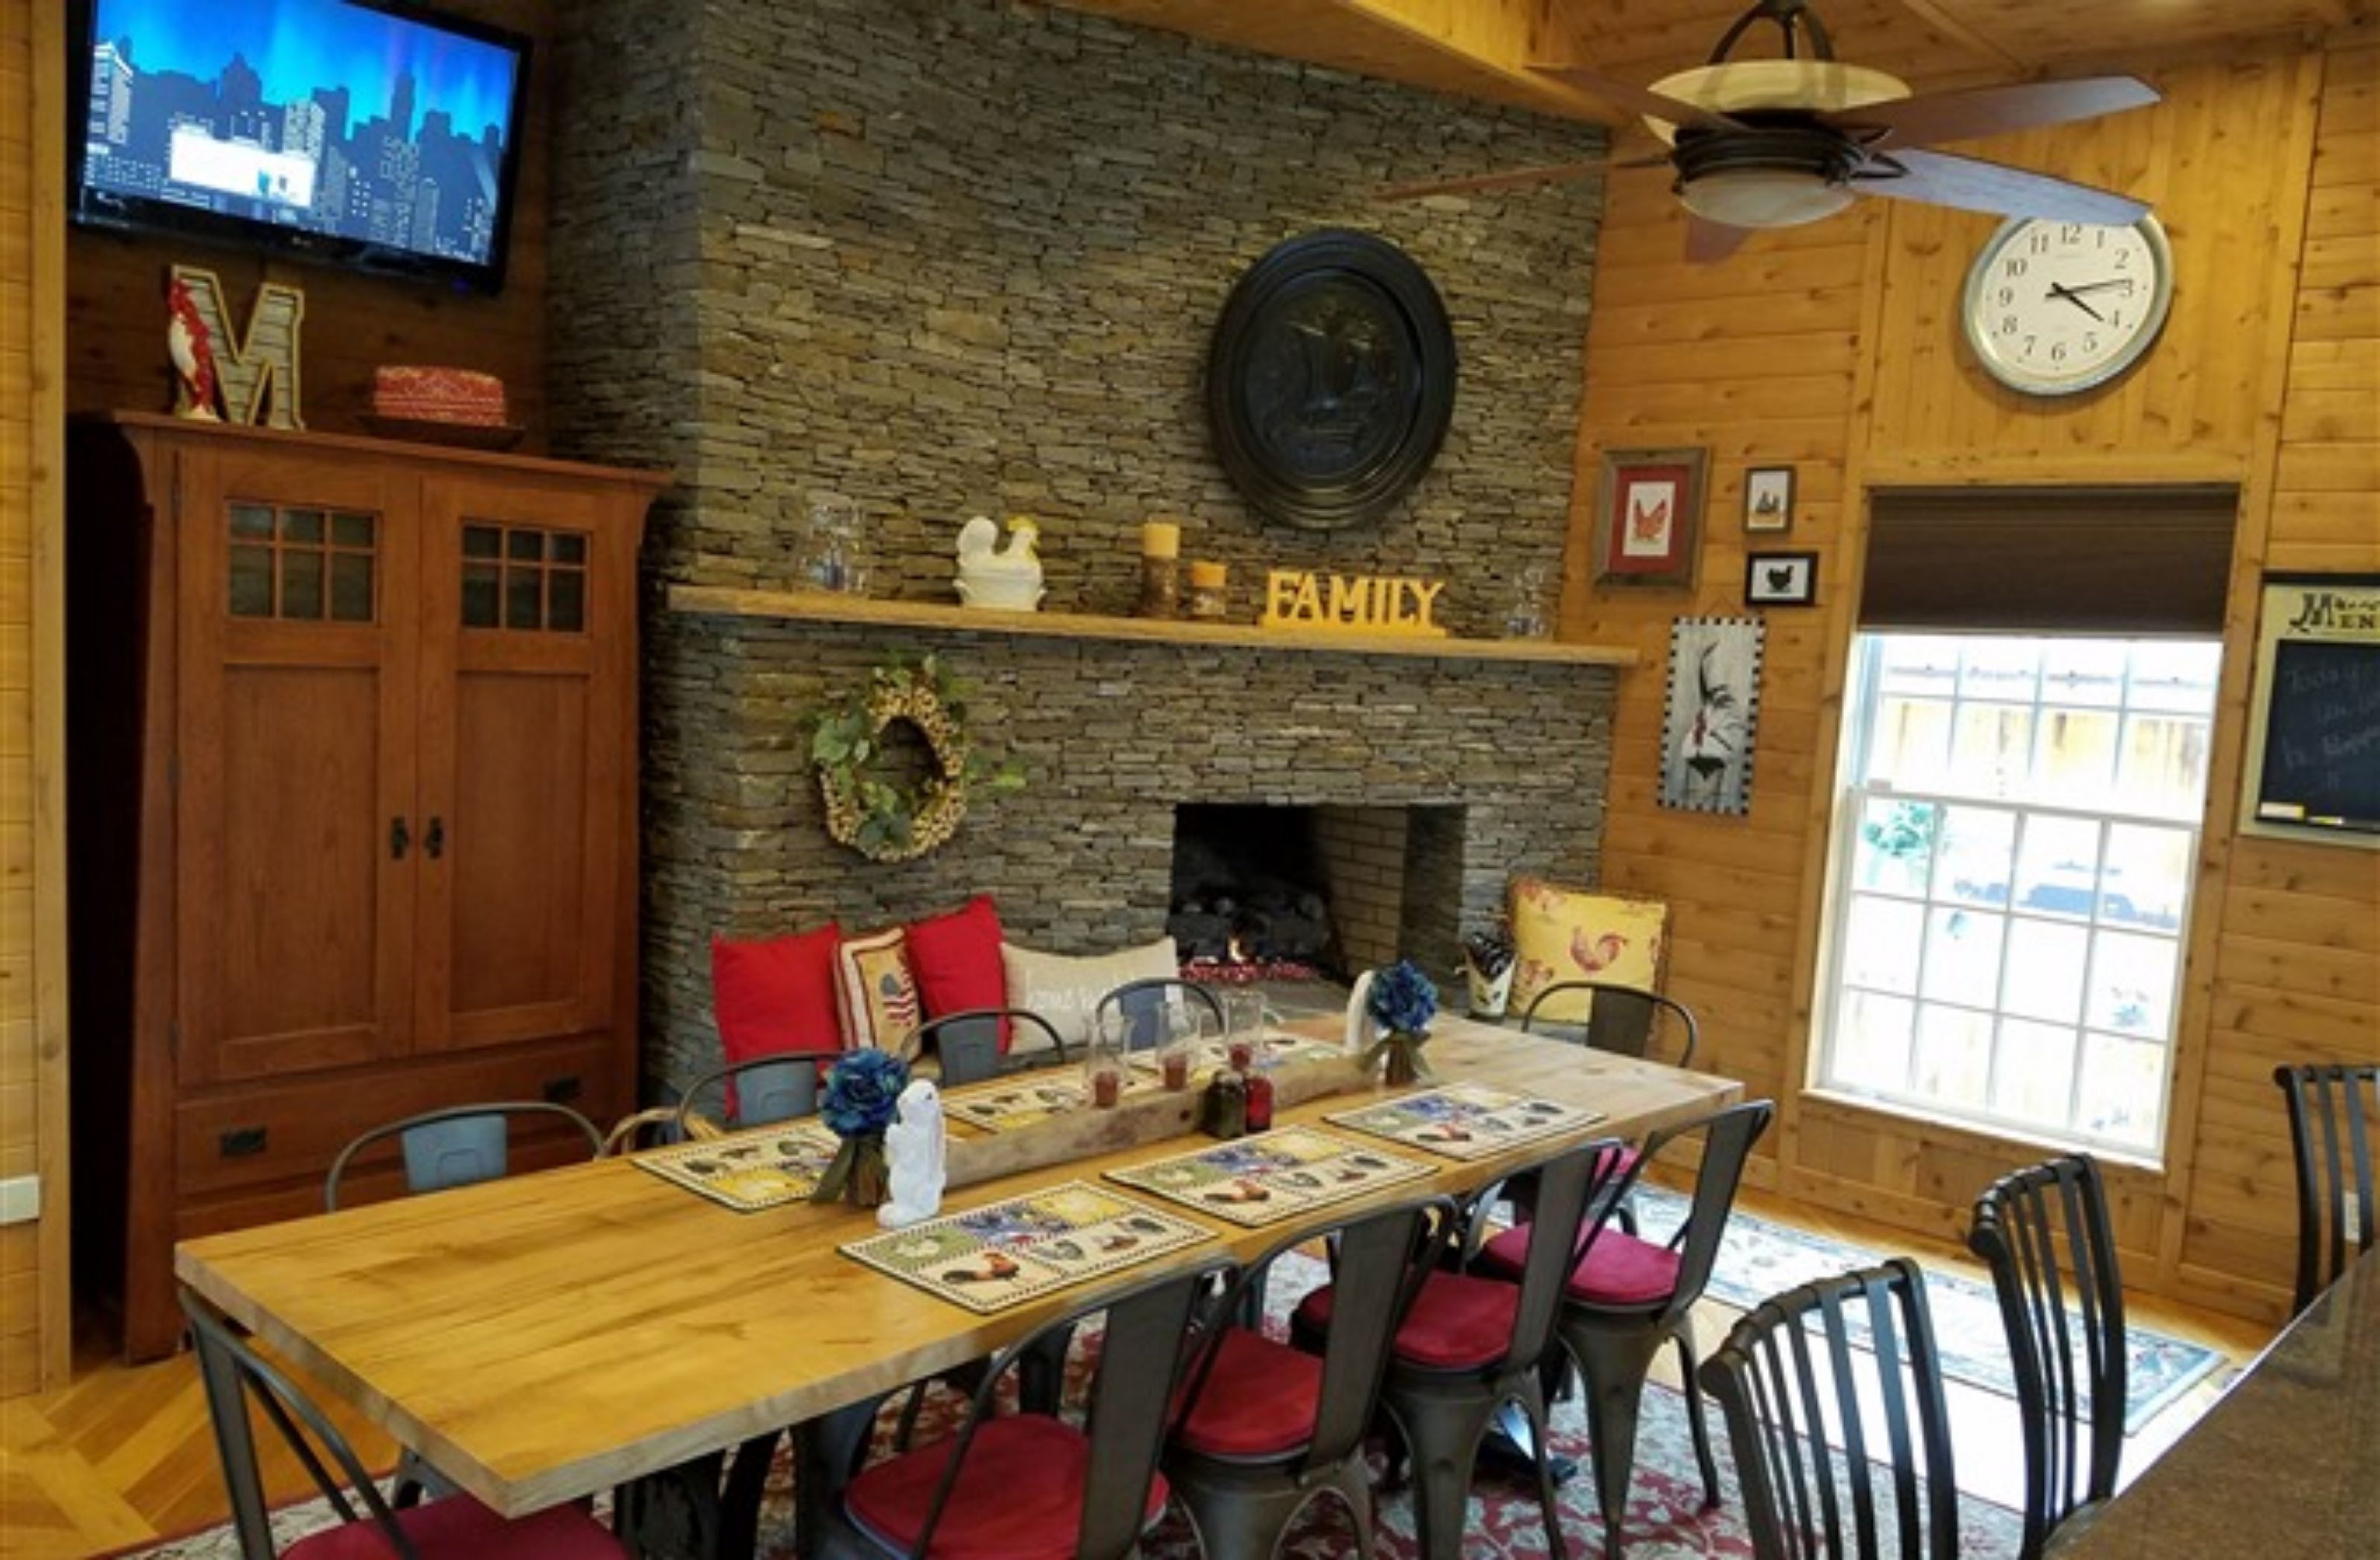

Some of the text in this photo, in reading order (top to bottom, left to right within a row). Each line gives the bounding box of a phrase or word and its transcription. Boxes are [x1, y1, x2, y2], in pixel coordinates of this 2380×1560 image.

[2030, 233, 2049, 254] 11
[2061, 222, 2082, 244] 12
[2097, 230, 2106, 248] 1
[2005, 257, 2027, 277] 10
[2114, 248, 2129, 270] 2
[1998, 289, 2014, 307] 9
[2119, 278, 2133, 298] 3
[2002, 315, 2018, 335] 8
[172, 265, 306, 431] M
[2024, 335, 2036, 356] 7
[2051, 341, 2067, 361] 6
[2083, 331, 2097, 353] 5
[1267, 569, 1445, 624] FAMILY
